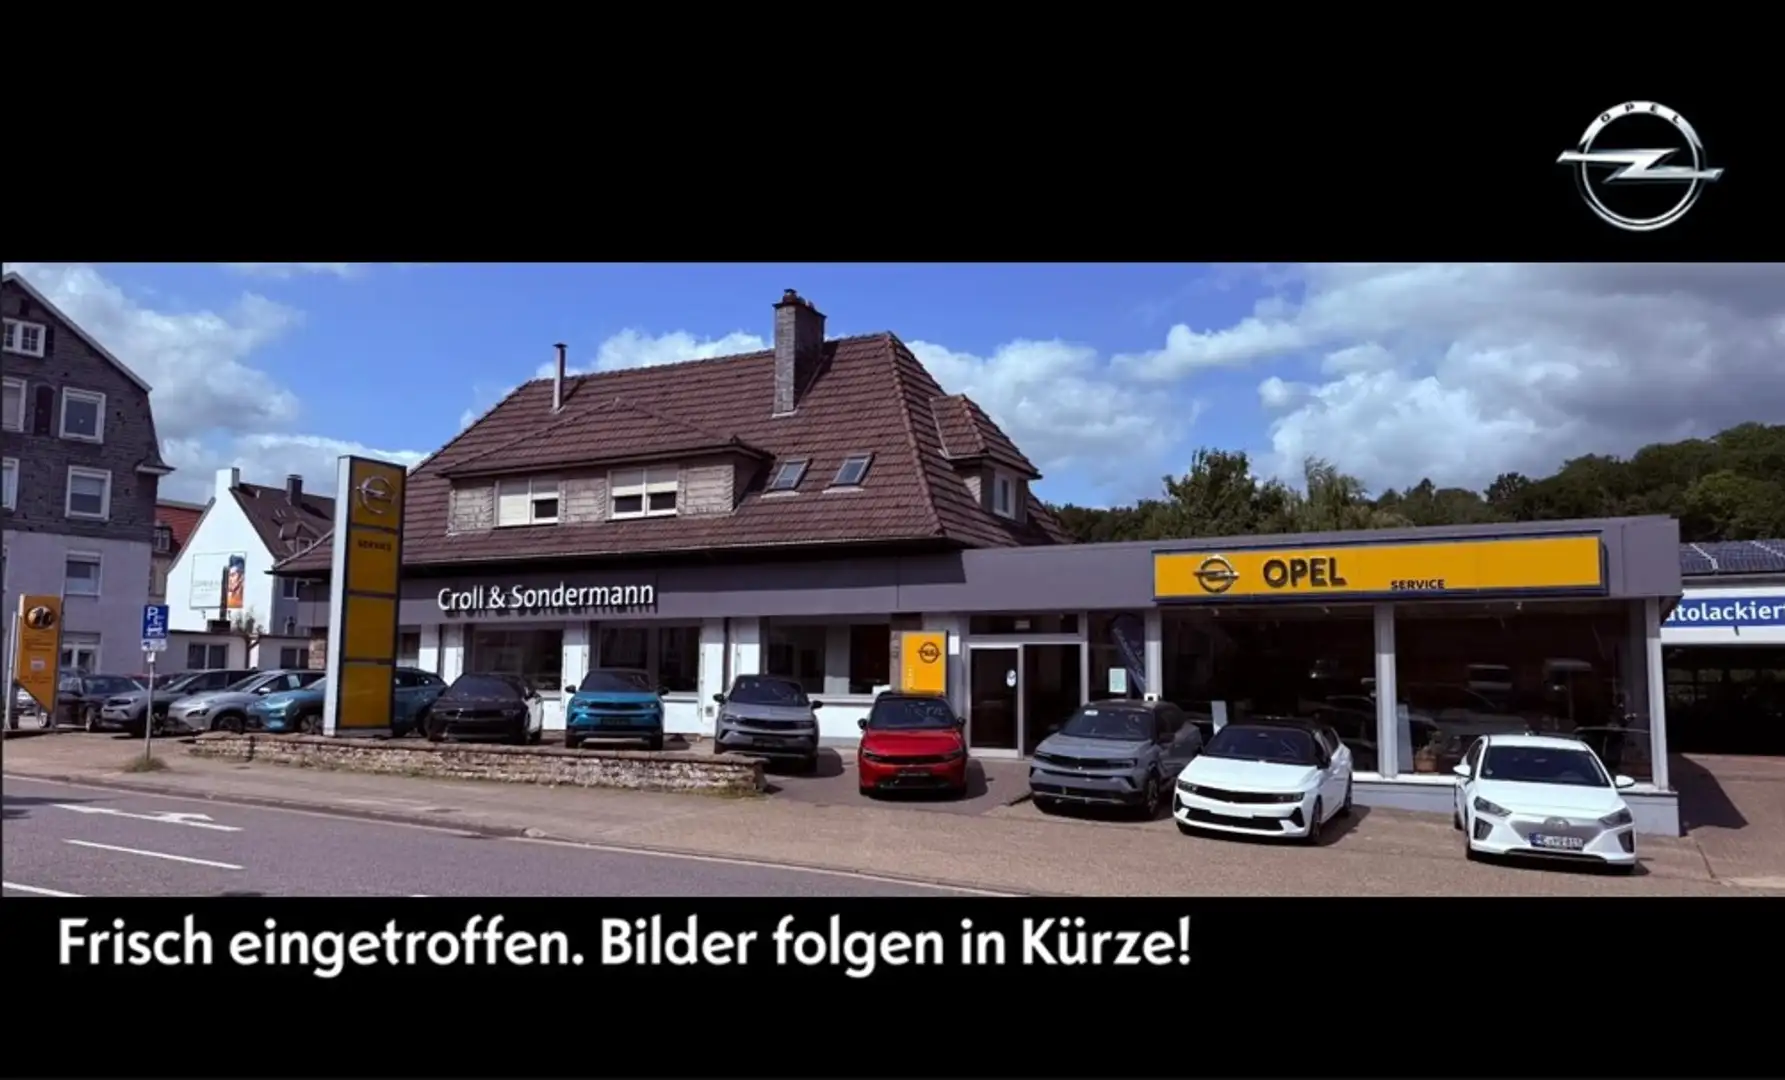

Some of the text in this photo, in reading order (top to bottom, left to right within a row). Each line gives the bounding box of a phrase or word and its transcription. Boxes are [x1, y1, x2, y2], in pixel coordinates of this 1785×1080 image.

[1263, 556, 1348, 589] OPEL
[1390, 578, 1445, 590] SERVICE
[437, 580, 655, 611] Croll & Sondermann
